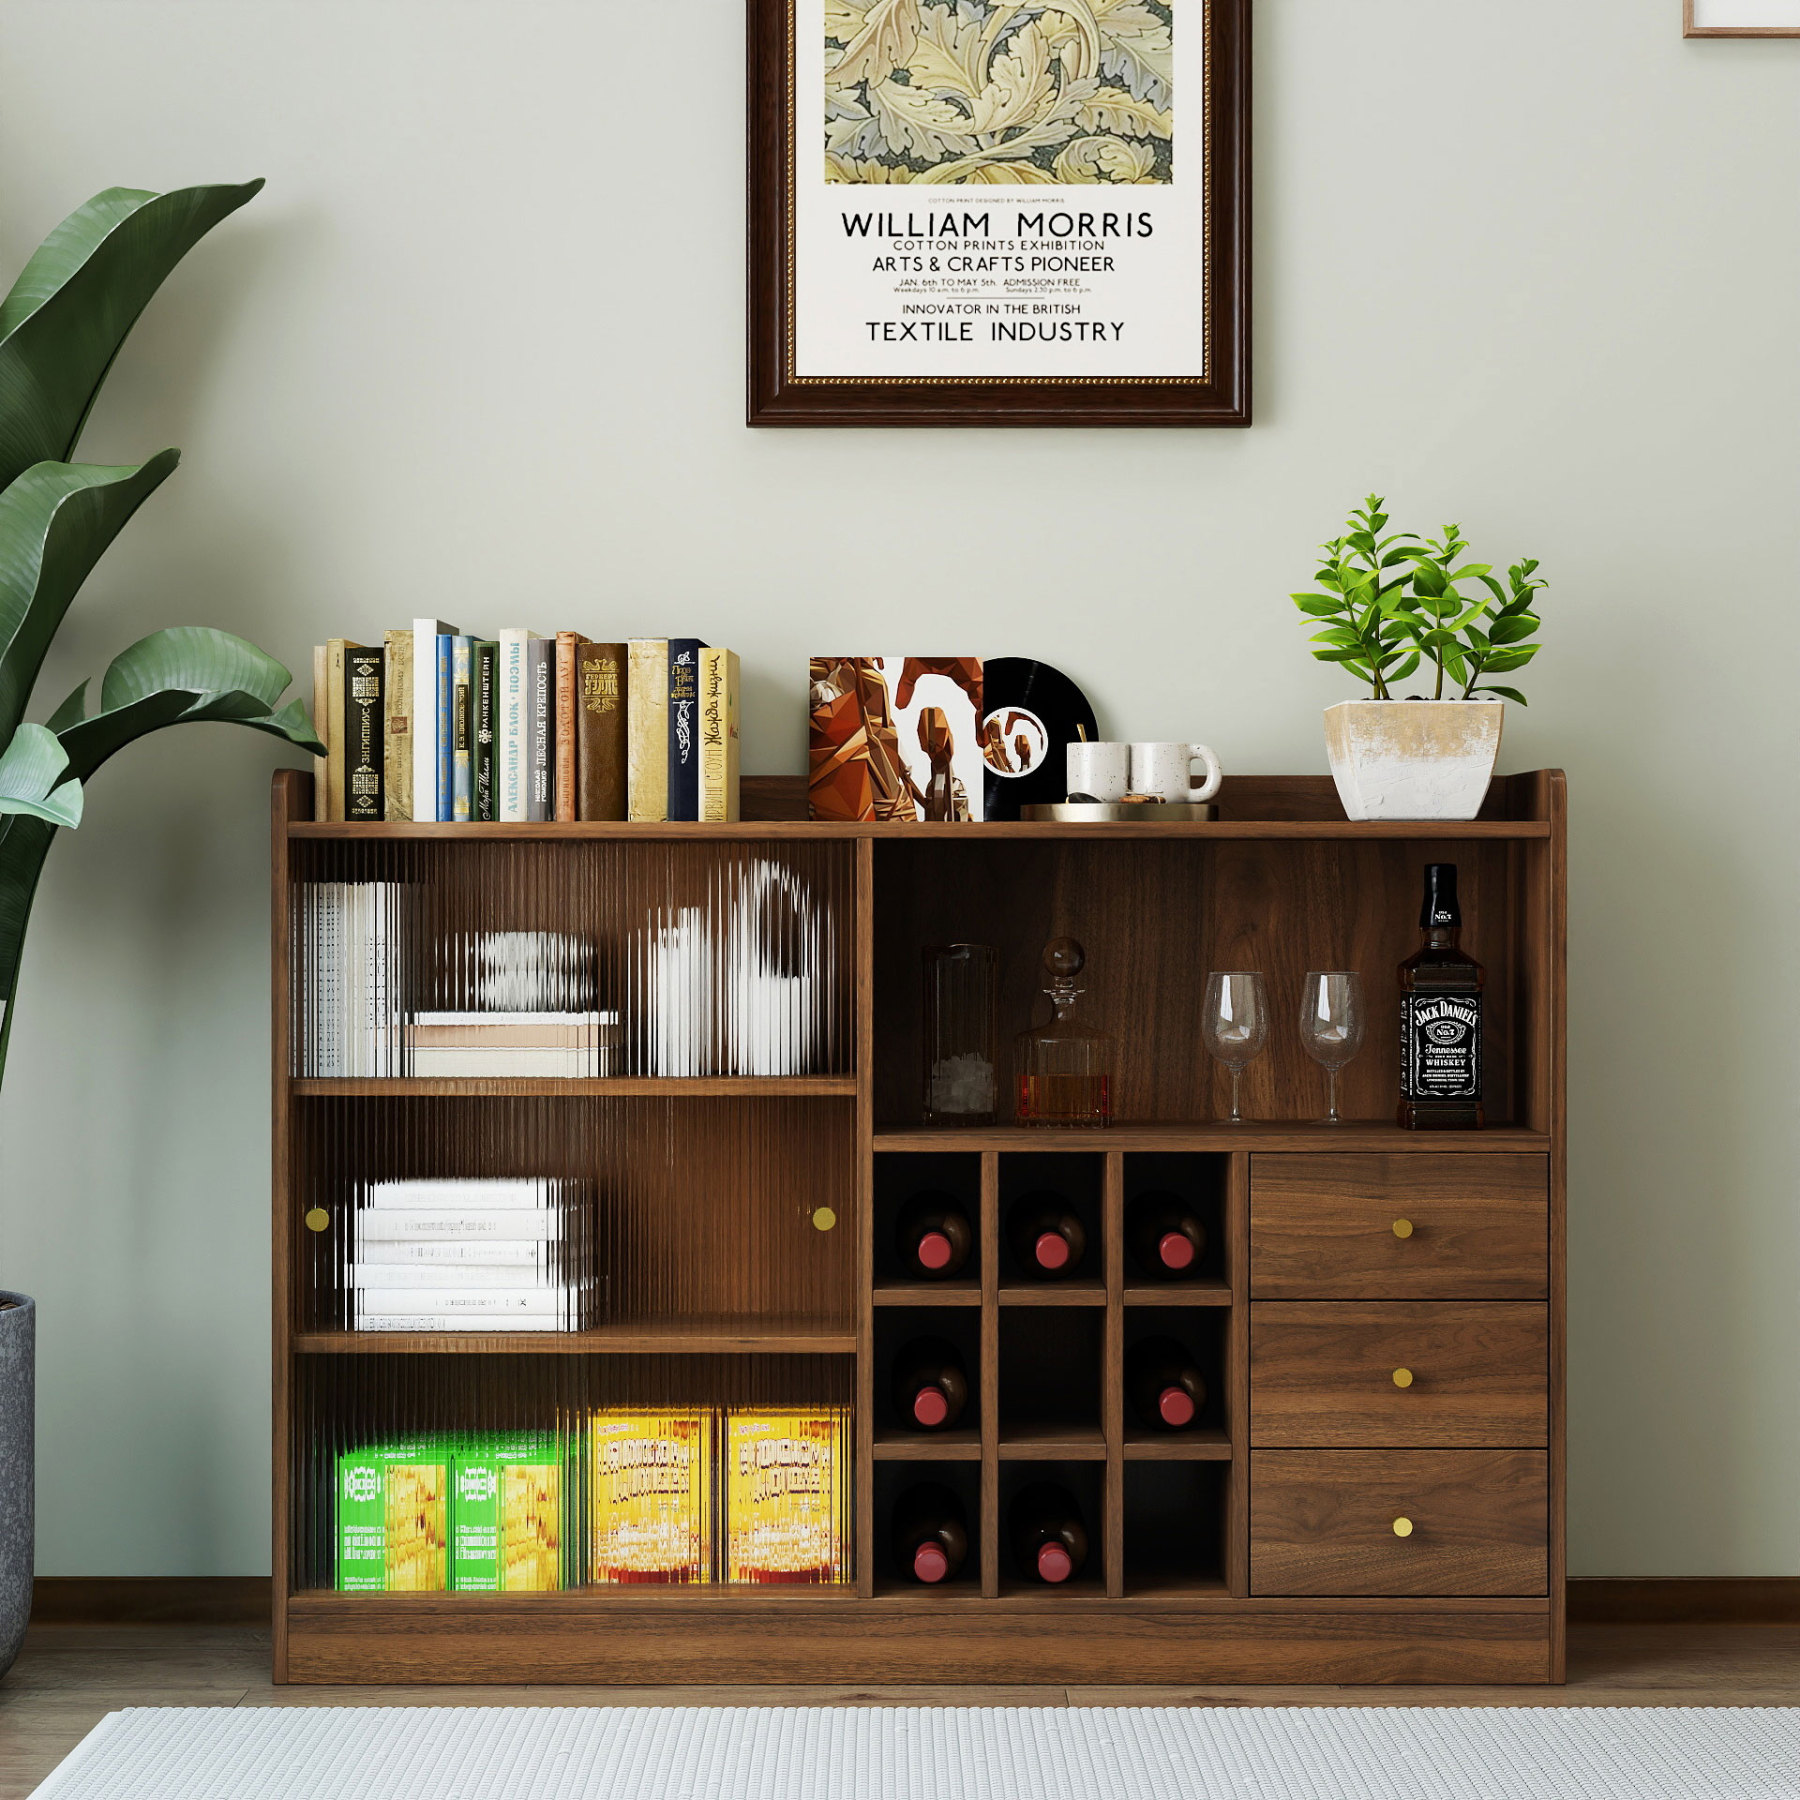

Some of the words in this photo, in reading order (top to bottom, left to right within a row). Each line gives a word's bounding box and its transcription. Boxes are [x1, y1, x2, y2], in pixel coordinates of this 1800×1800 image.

[841, 212, 990, 238] WILLIAM
[1017, 212, 1154, 238] MORRIS
[892, 239, 958, 251] COTTON
[963, 239, 1015, 251] PRINTS
[1020, 239, 1105, 251] EXHIBITION
[872, 256, 924, 272] ARTS
[929, 256, 941, 272] &
[947, 256, 1025, 272] CRAFTS
[1031, 256, 1116, 272] PIONEER
[921, 278, 938, 287] 6th
[941, 278, 955, 287] TO
[957, 278, 978, 287] MAY
[1004, 278, 1056, 287] ADMISSION
[1057, 278, 1081, 287] FREE
[902, 304, 982, 315] INNOVATOR
[987, 304, 1000, 315] IN
[1003, 304, 1029, 315] THE
[1032, 304, 1081, 315] BRITISH
[865, 321, 974, 342] TEXTILE
[991, 321, 1125, 342] INDUSTRY
[508, 642, 520, 693] ПОЭМЫ
[707, 655, 722, 699] жизни
[536, 661, 547, 718] КРЕПОСТЬ
[508, 702, 519, 736] БЛОК
[704, 700, 722, 746] Жажда
[536, 720, 547, 767] ЛЕСНАЯ
[507, 740, 519, 813] АЛЕКСАНДР
[704, 749, 723, 781] СТОУН
[1414, 1005, 1440, 1027] JACK
[1425, 1043, 1467, 1054] Tennessee
[1425, 1059, 1466, 1067] WHISKEY
